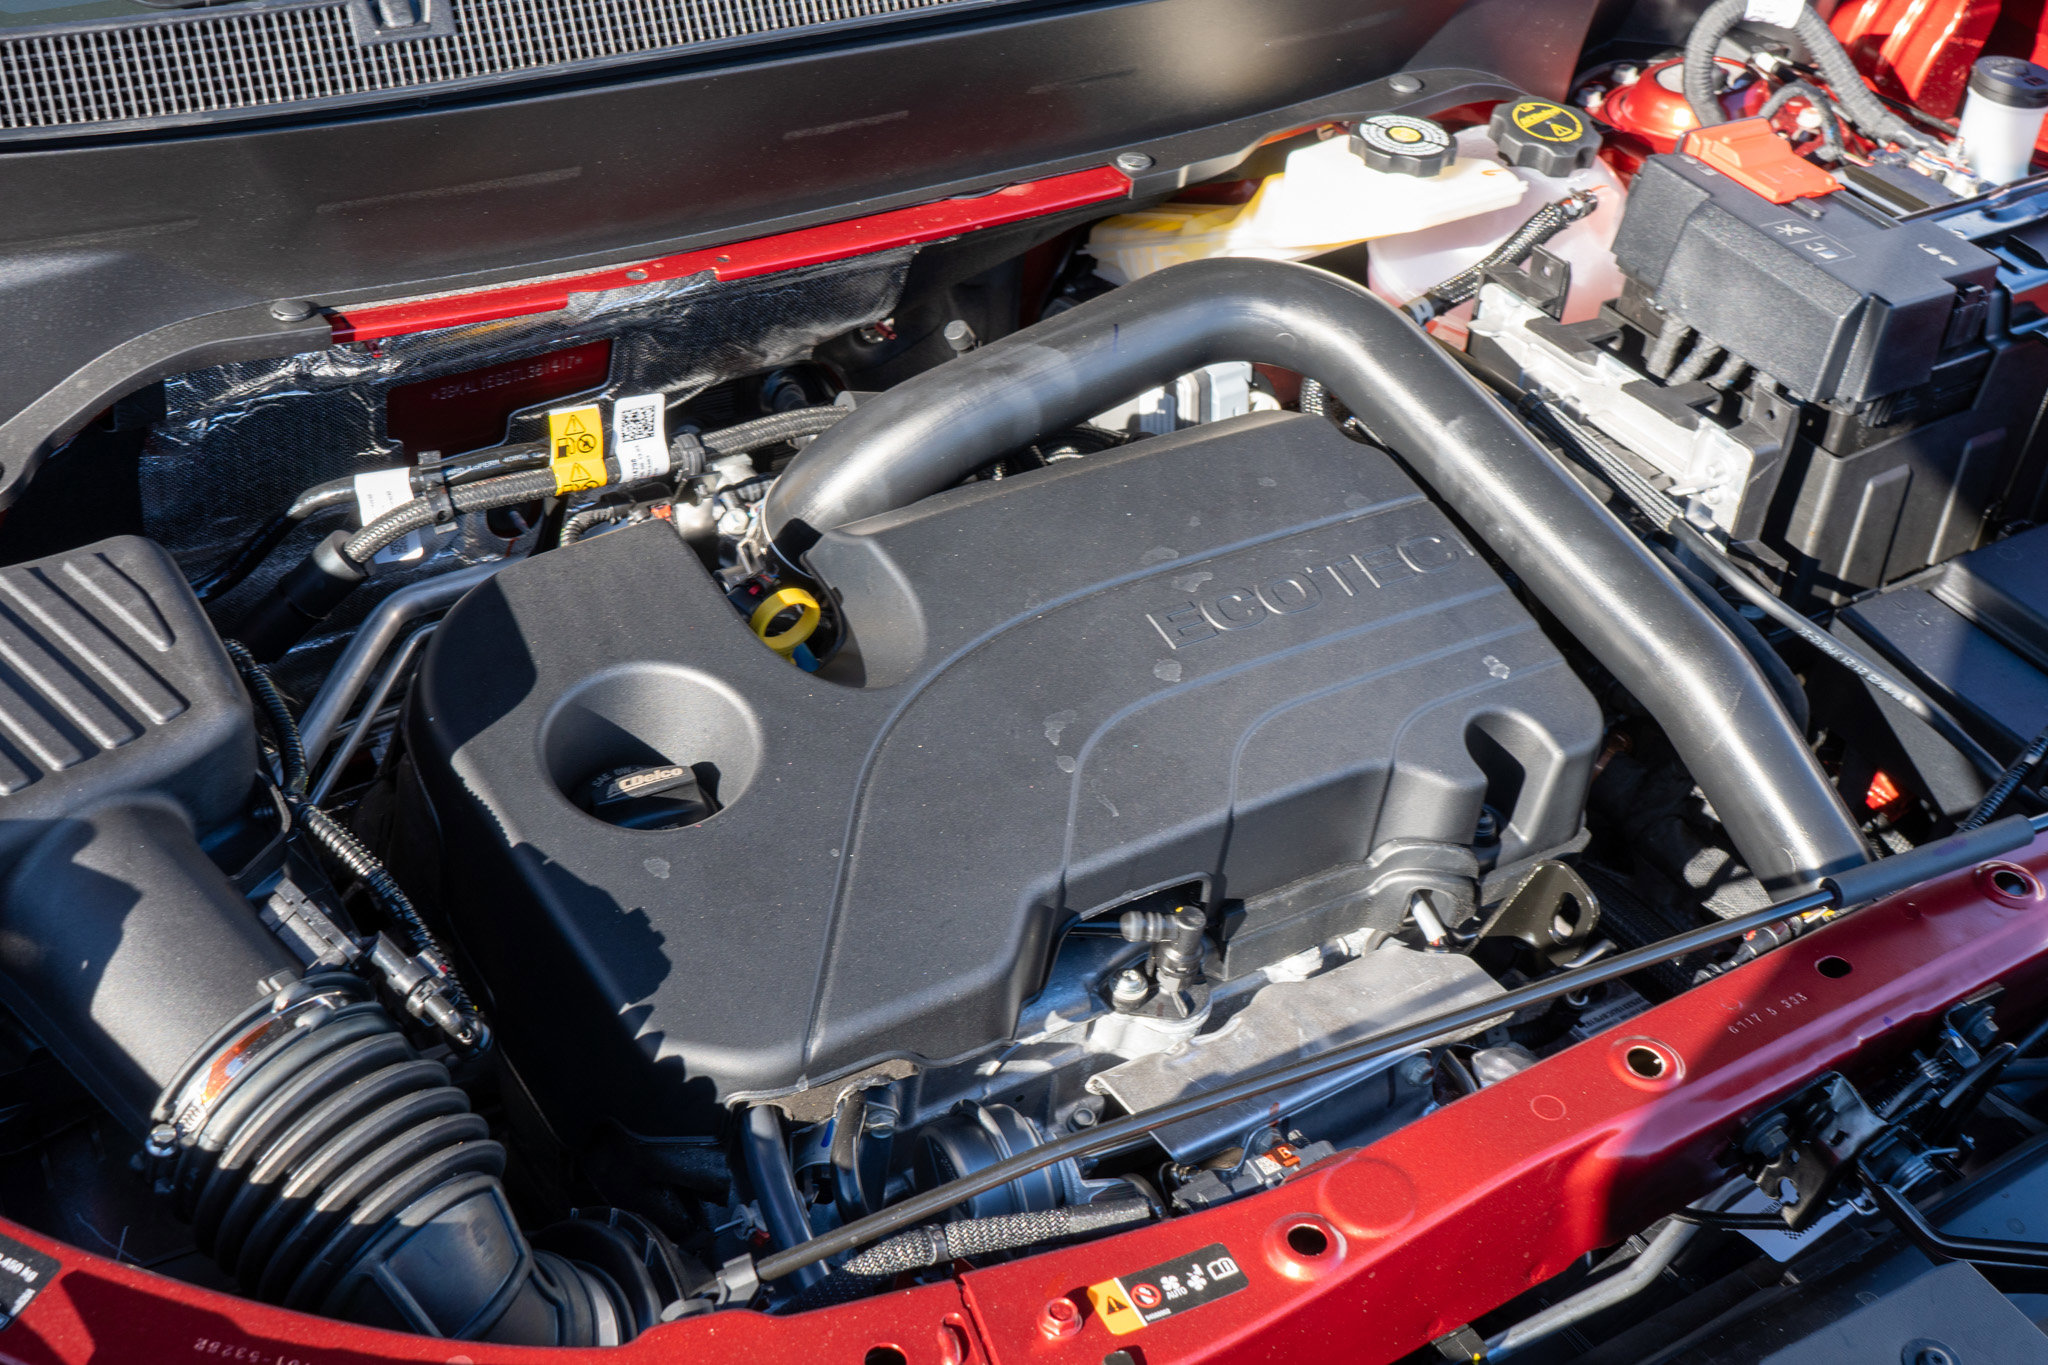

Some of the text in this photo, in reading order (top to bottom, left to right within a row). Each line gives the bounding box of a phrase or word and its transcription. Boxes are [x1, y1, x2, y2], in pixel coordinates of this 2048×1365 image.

[1145, 533, 1460, 650] ECOTEC
[607, 768, 682, 794] ACDelco
[1166, 1286, 1188, 1301] AUTO
